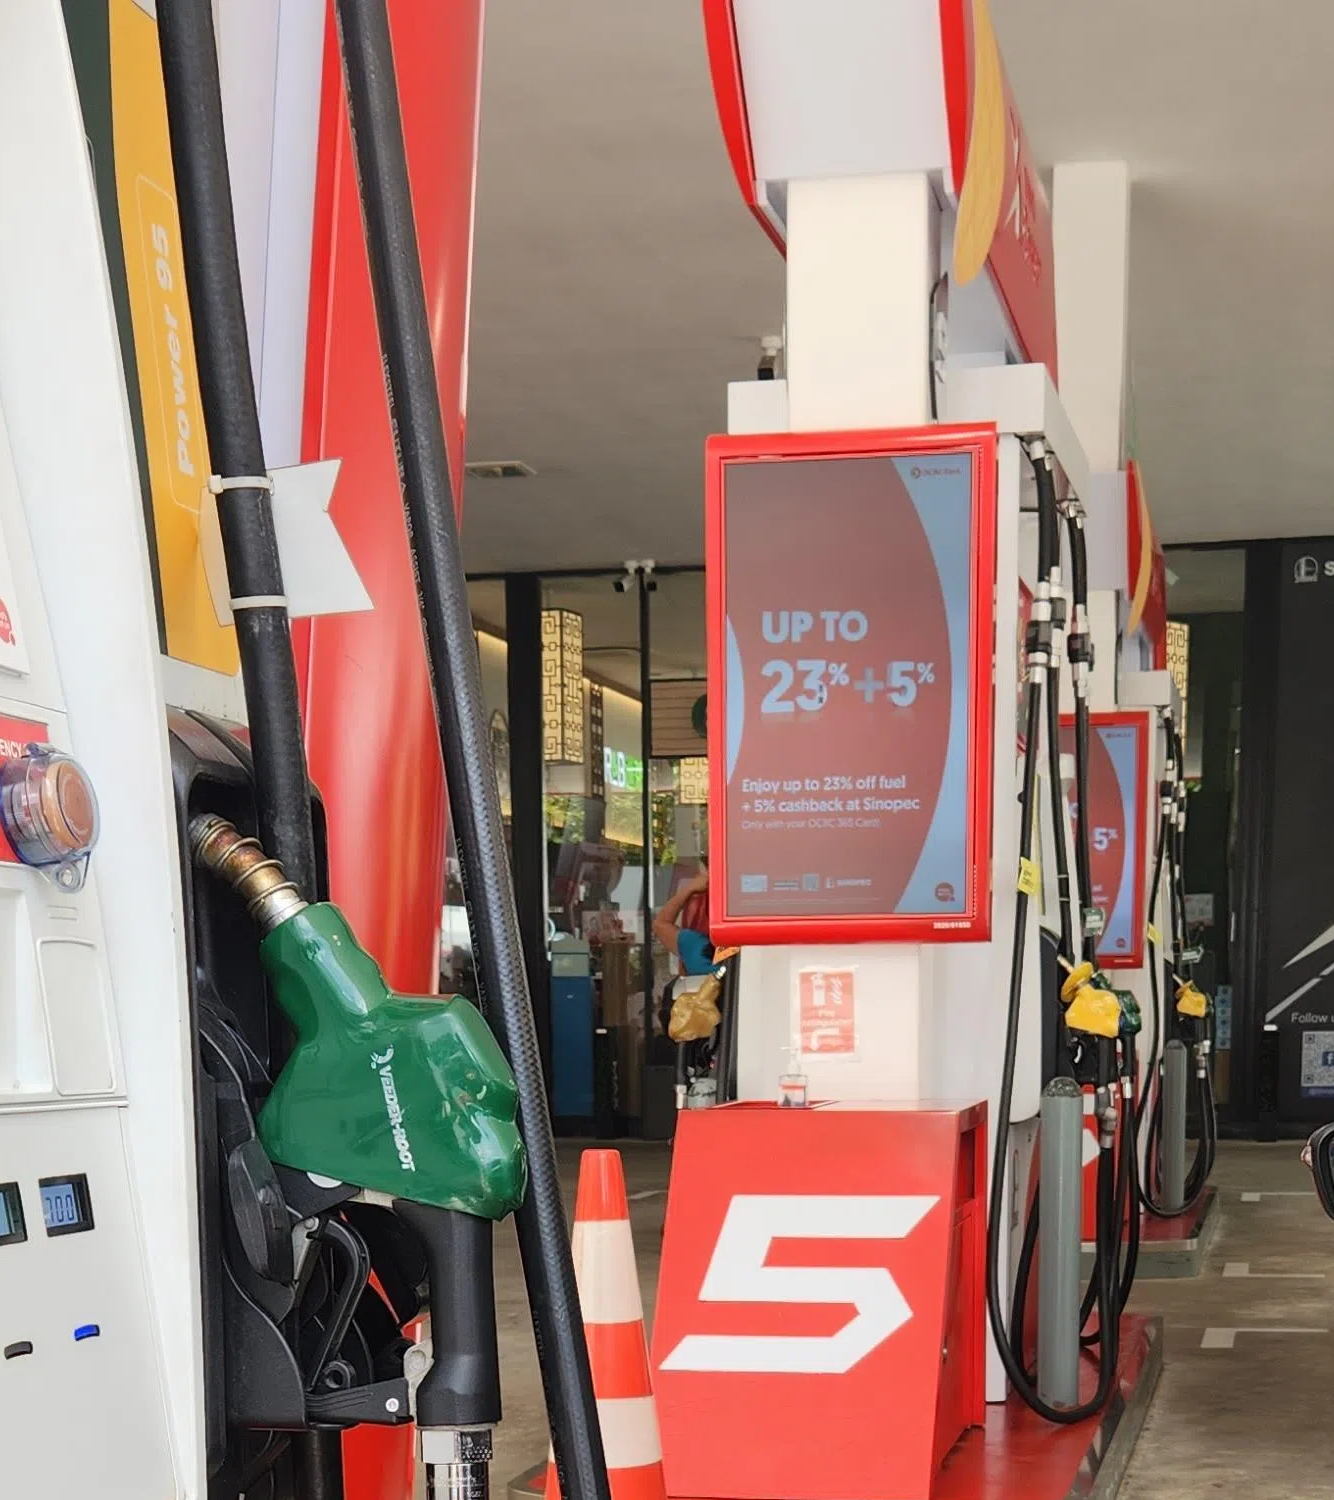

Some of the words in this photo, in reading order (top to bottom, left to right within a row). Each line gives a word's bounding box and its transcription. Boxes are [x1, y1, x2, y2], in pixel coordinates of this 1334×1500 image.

[151, 222, 175, 292] 95
[164, 303, 196, 477] Power
[761, 610, 814, 644] UP
[820, 610, 869, 642] TO
[760, 658, 851, 714] 23%
[741, 778, 779, 794] Enjoy
[782, 781, 801, 795] up
[805, 776, 820, 791] to
[822, 775, 853, 791] 23%
[855, 774, 875, 790] off
[878, 773, 906, 788] fuel
[754, 799, 776, 814] 5%
[778, 796, 843, 812] cashback
[845, 797, 860, 811] at
[863, 795, 920, 812] Sinopec
[1290, 1012, 1327, 1024] Follow
[379, 1066, 416, 1173] VEEDER-ROOT
[660, 1194, 941, 1374] 5
